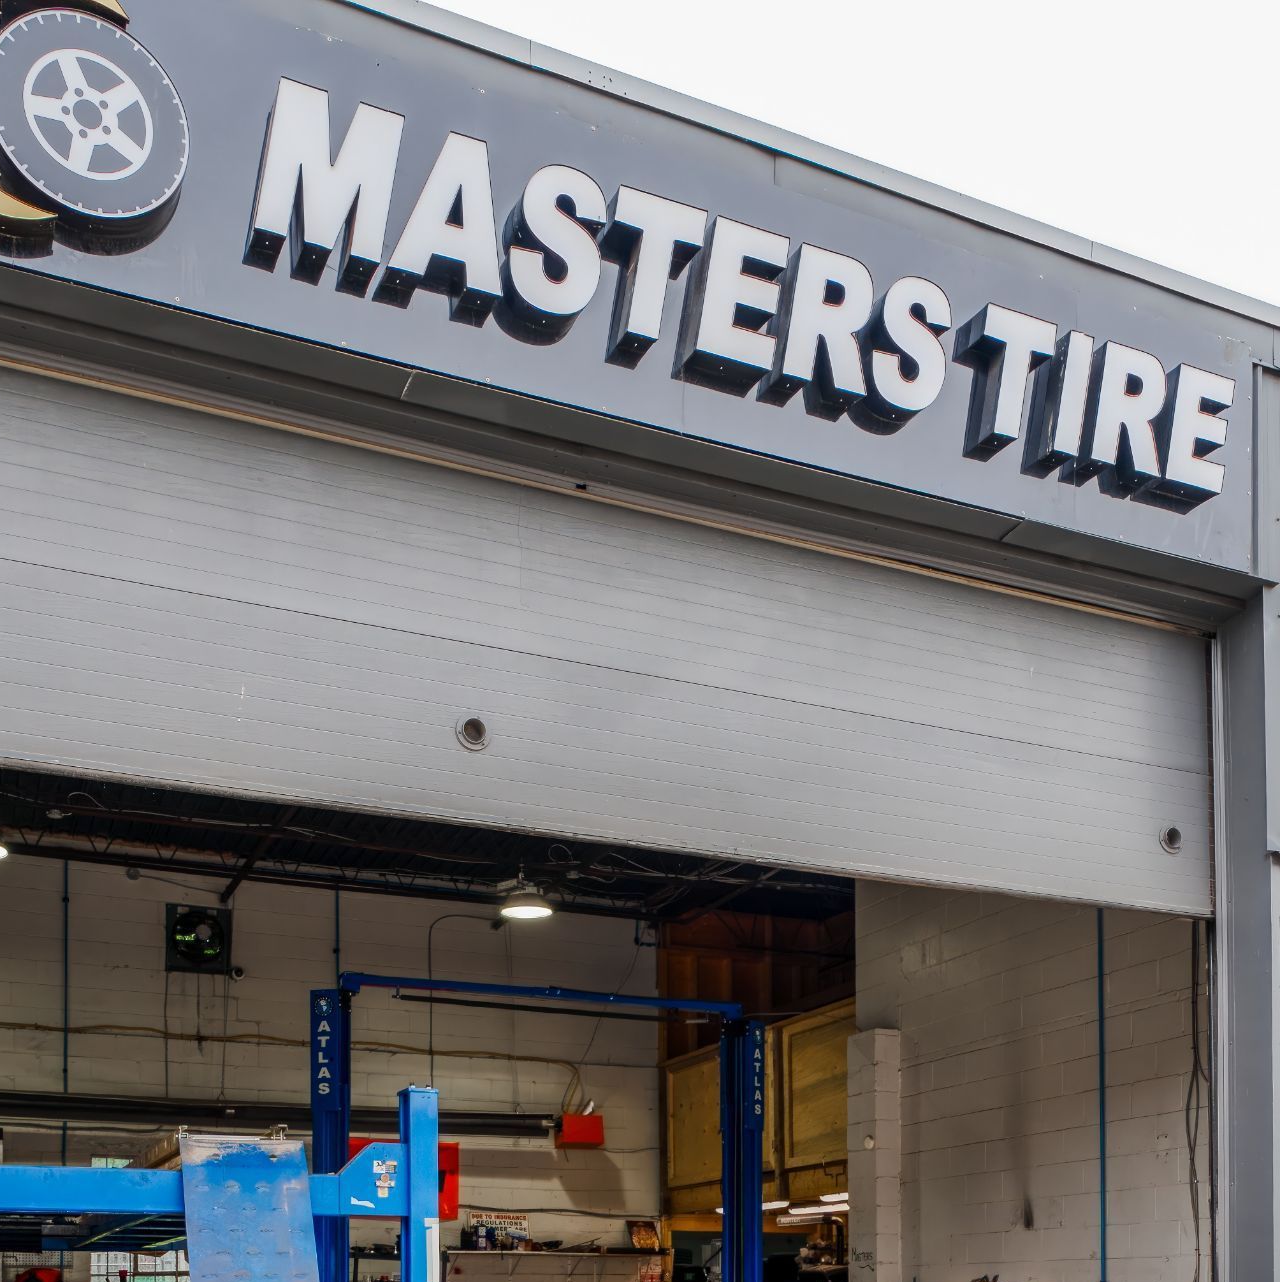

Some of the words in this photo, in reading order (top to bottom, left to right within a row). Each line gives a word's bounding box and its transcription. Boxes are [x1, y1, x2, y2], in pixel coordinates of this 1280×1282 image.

[248, 77, 952, 425] MASTERS
[968, 303, 1235, 505] TIRE
[317, 1020, 331, 1095] ATLAS
[753, 1048, 762, 1115] ATLAS
